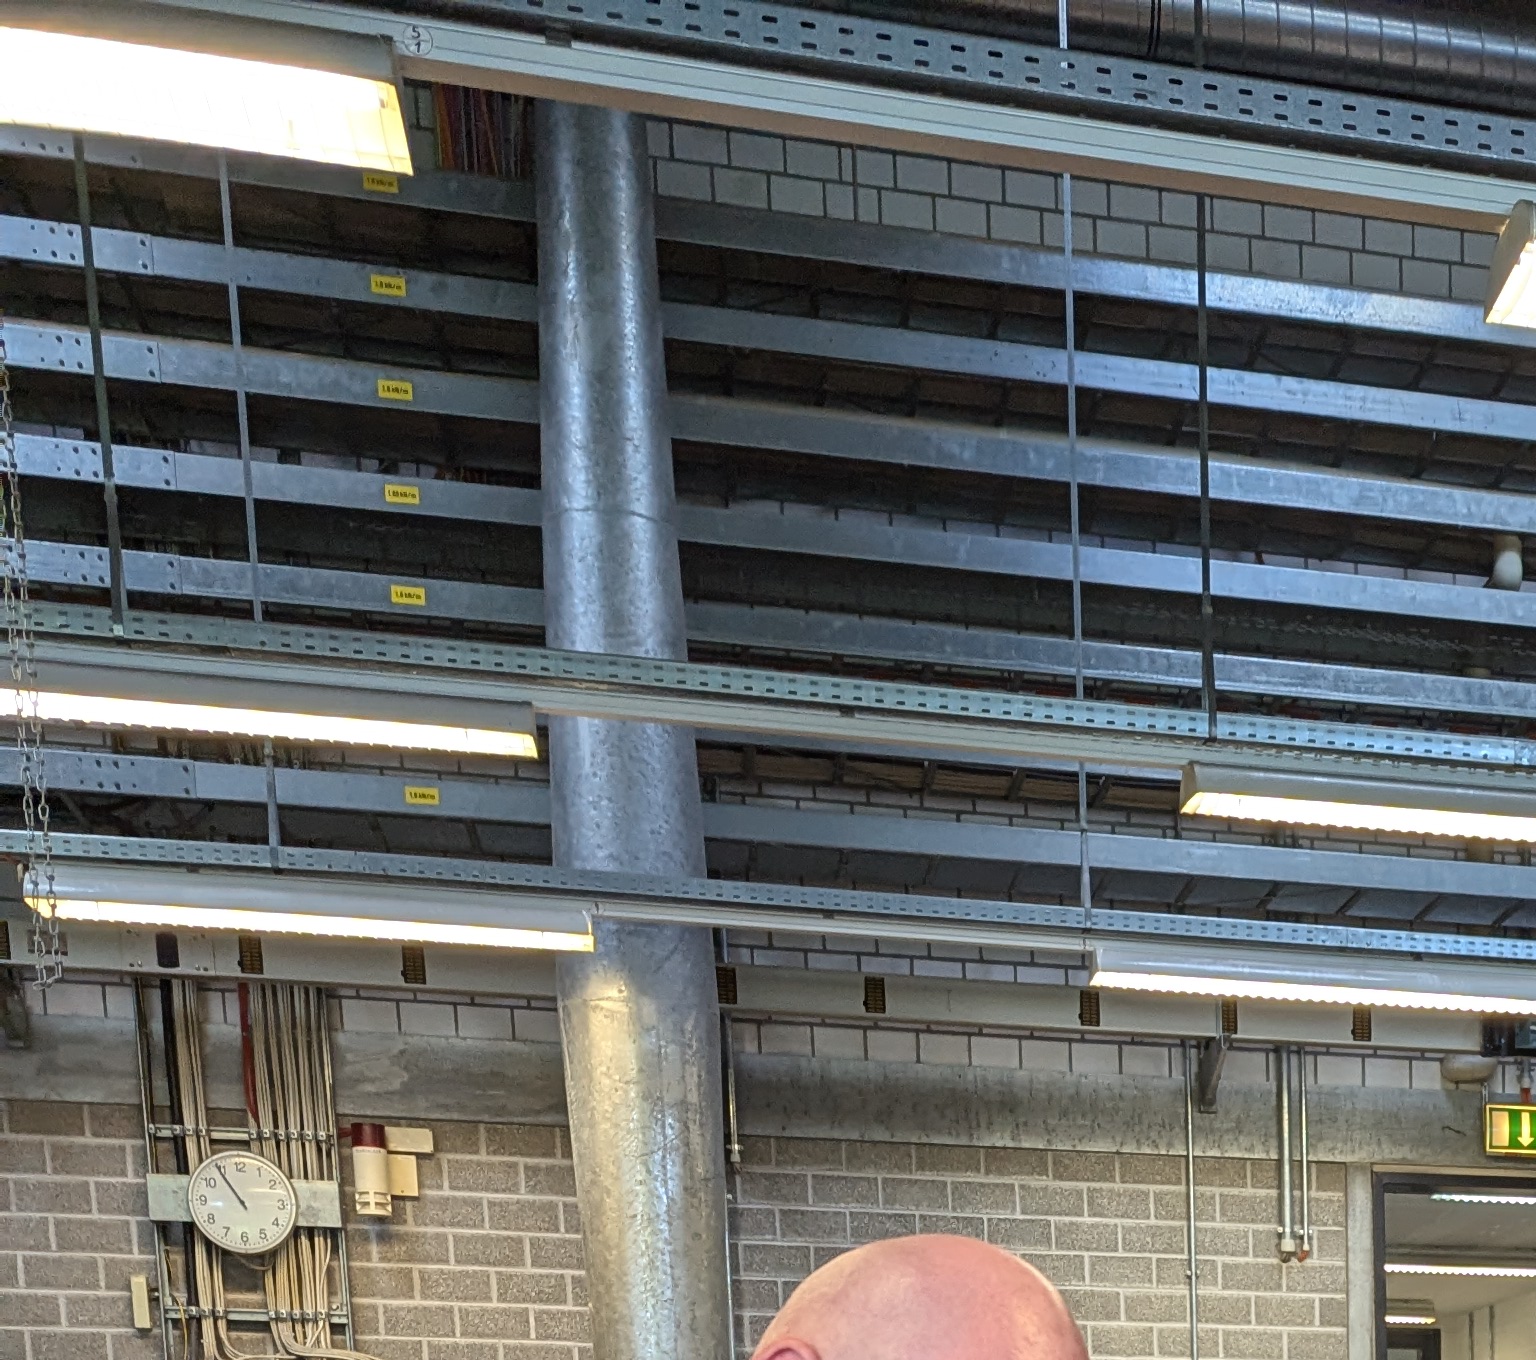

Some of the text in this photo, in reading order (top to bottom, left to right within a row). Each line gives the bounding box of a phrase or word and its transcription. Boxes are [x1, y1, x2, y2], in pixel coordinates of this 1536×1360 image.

[234, 1161, 247, 1173] 12
[257, 1167, 262, 1178] 1
[203, 1178, 217, 1189] 10
[268, 1179, 278, 1190] 2
[198, 1194, 208, 1206] 9
[276, 1199, 286, 1211] 3
[206, 1213, 216, 1225] 8
[271, 1217, 280, 1229] 4
[222, 1226, 231, 1238] 7
[240, 1231, 250, 1243] 6
[258, 1228, 268, 1240] 5
